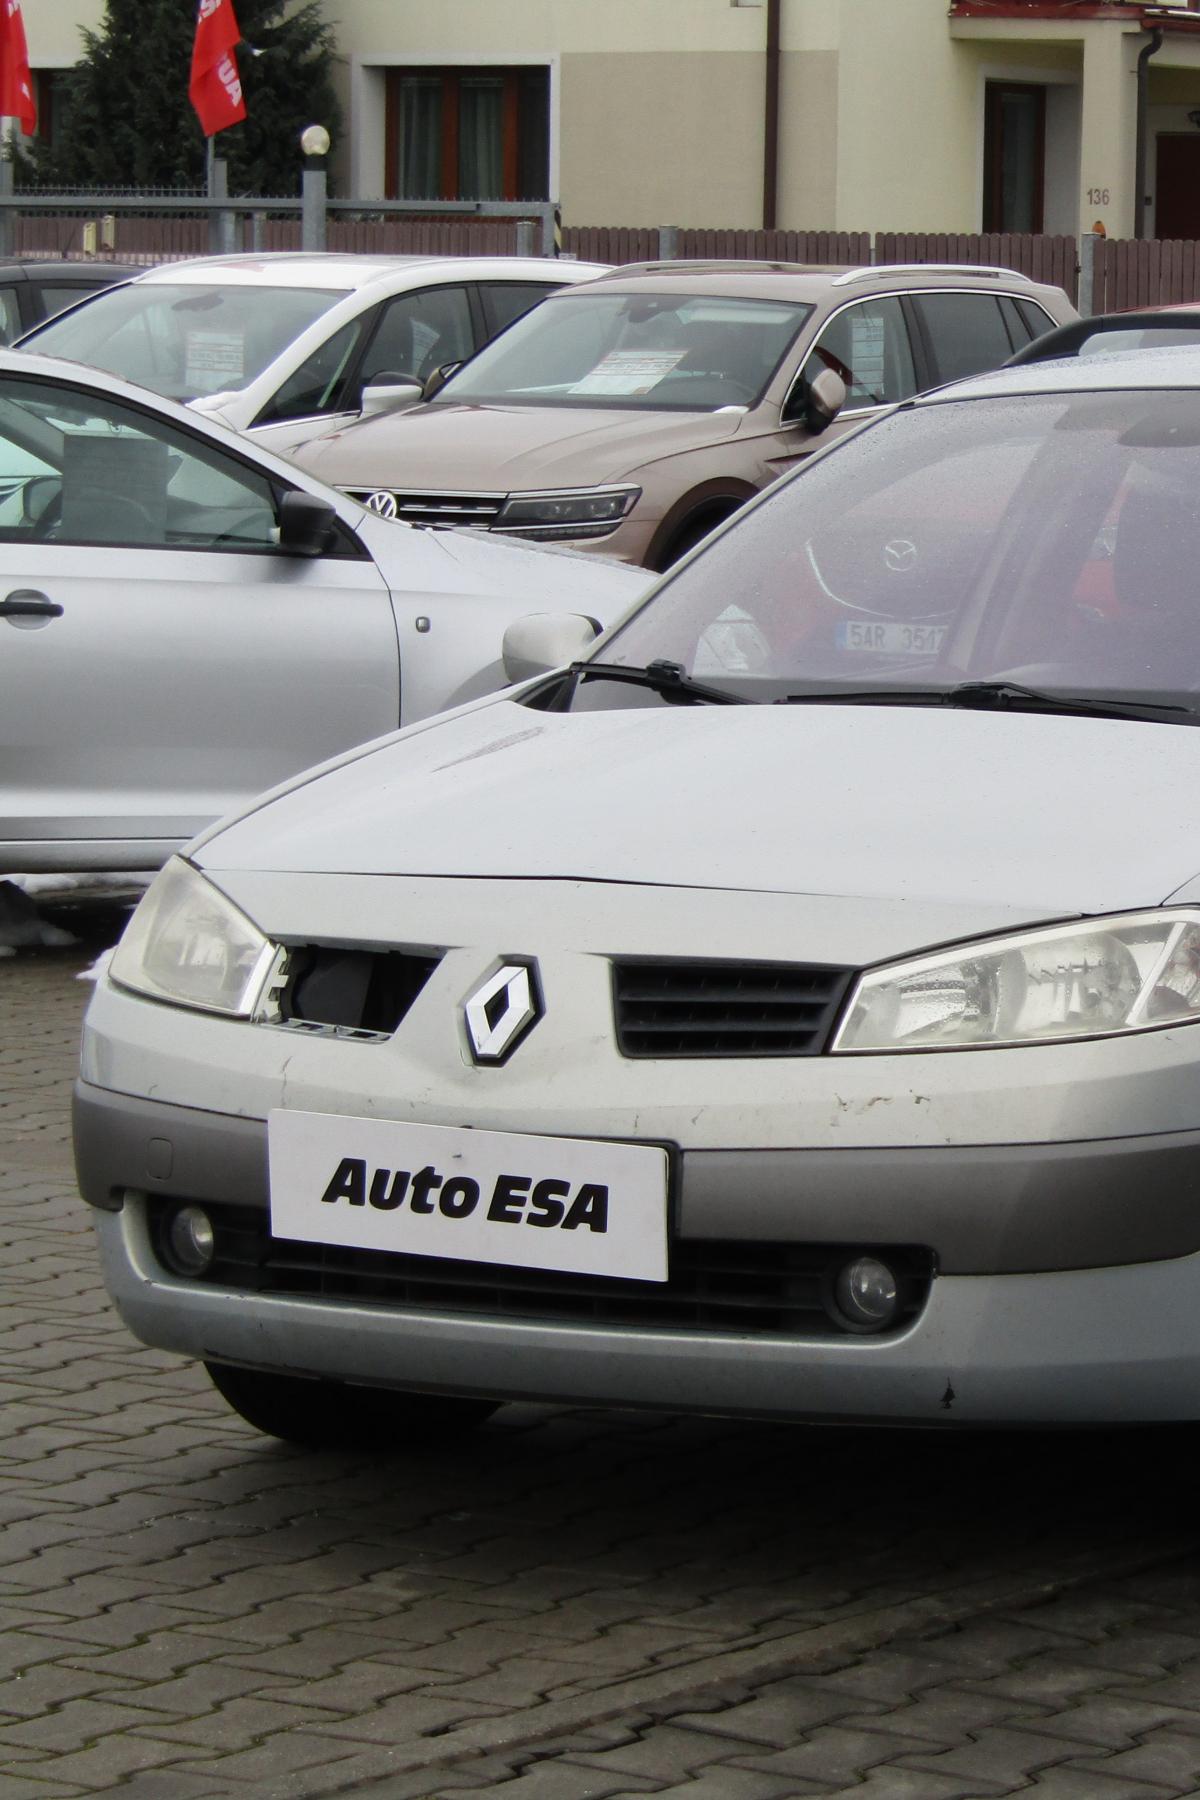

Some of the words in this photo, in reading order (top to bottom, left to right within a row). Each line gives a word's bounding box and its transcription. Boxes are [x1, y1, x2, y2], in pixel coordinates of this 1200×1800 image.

[1087, 188, 1110, 206] 136
[849, 624, 886, 648] 5AR
[321, 1157, 480, 1218] Auto
[487, 1174, 609, 1233] ESA
